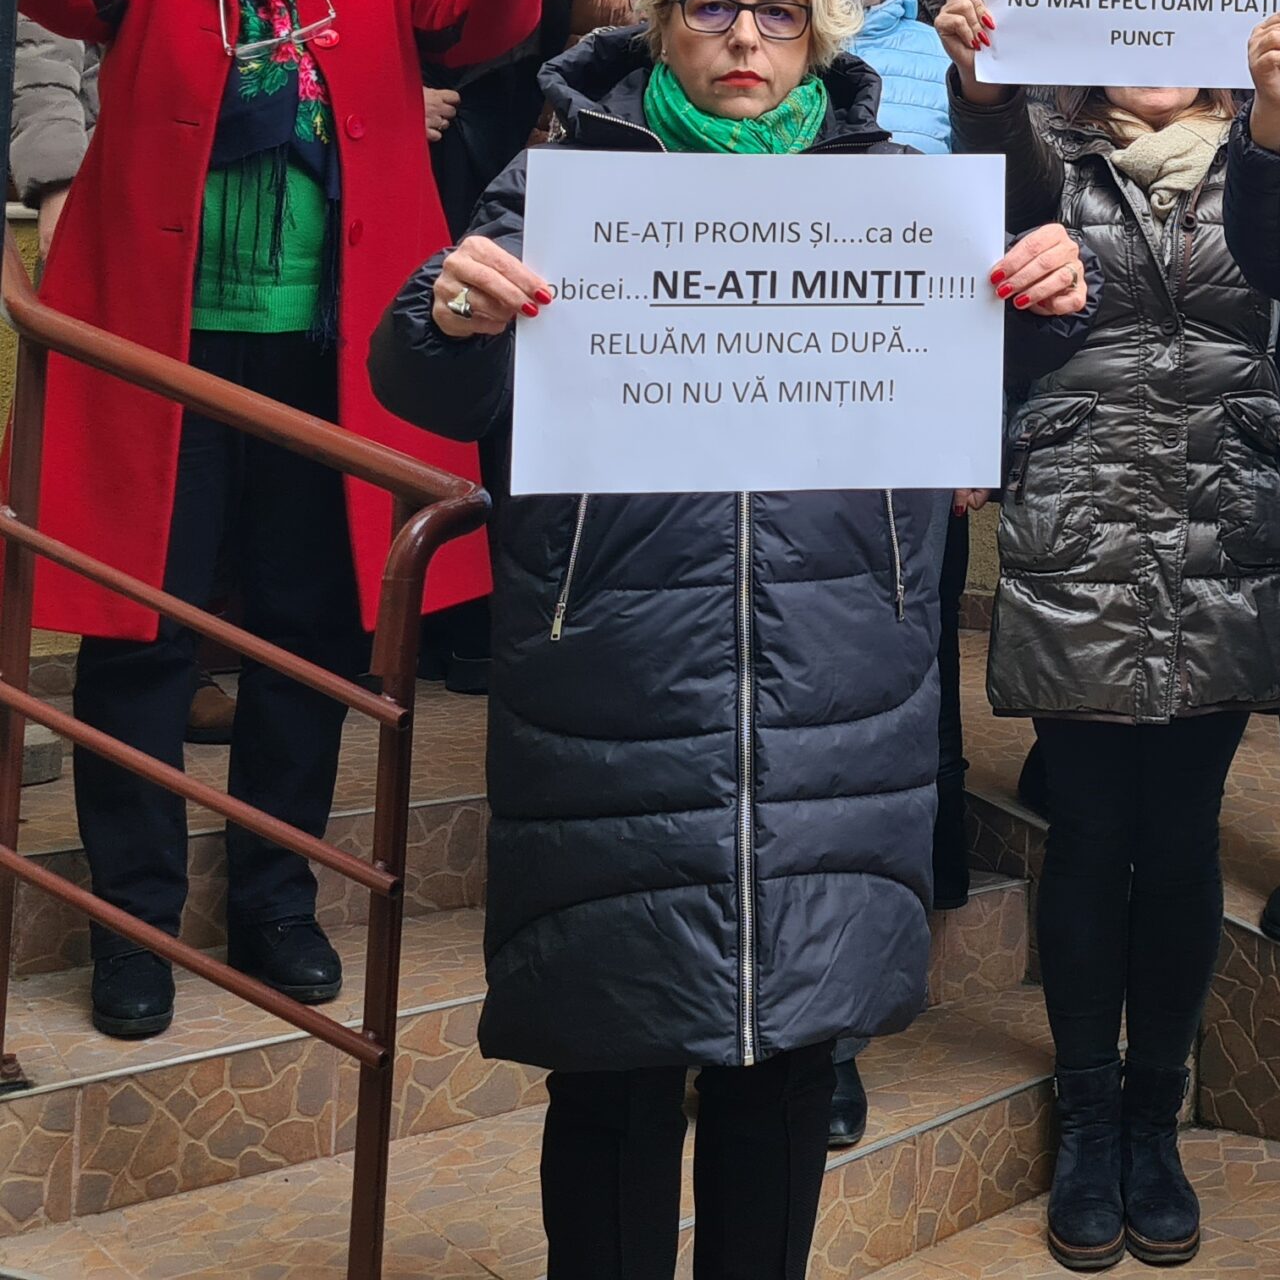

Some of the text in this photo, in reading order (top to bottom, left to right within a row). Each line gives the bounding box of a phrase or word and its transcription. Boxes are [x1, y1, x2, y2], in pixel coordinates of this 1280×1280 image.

[1111, 30, 1175, 47] PUNCT
[594, 222, 684, 248] NE-AȚI
[695, 221, 801, 244] PROMIS
[902, 222, 933, 244] de
[590, 326, 928, 356] RELUĂM MUNCA DUPĂ...
[623, 382, 672, 405] NOI
[683, 382, 722, 404] NU
[733, 376, 768, 403] VĂ
